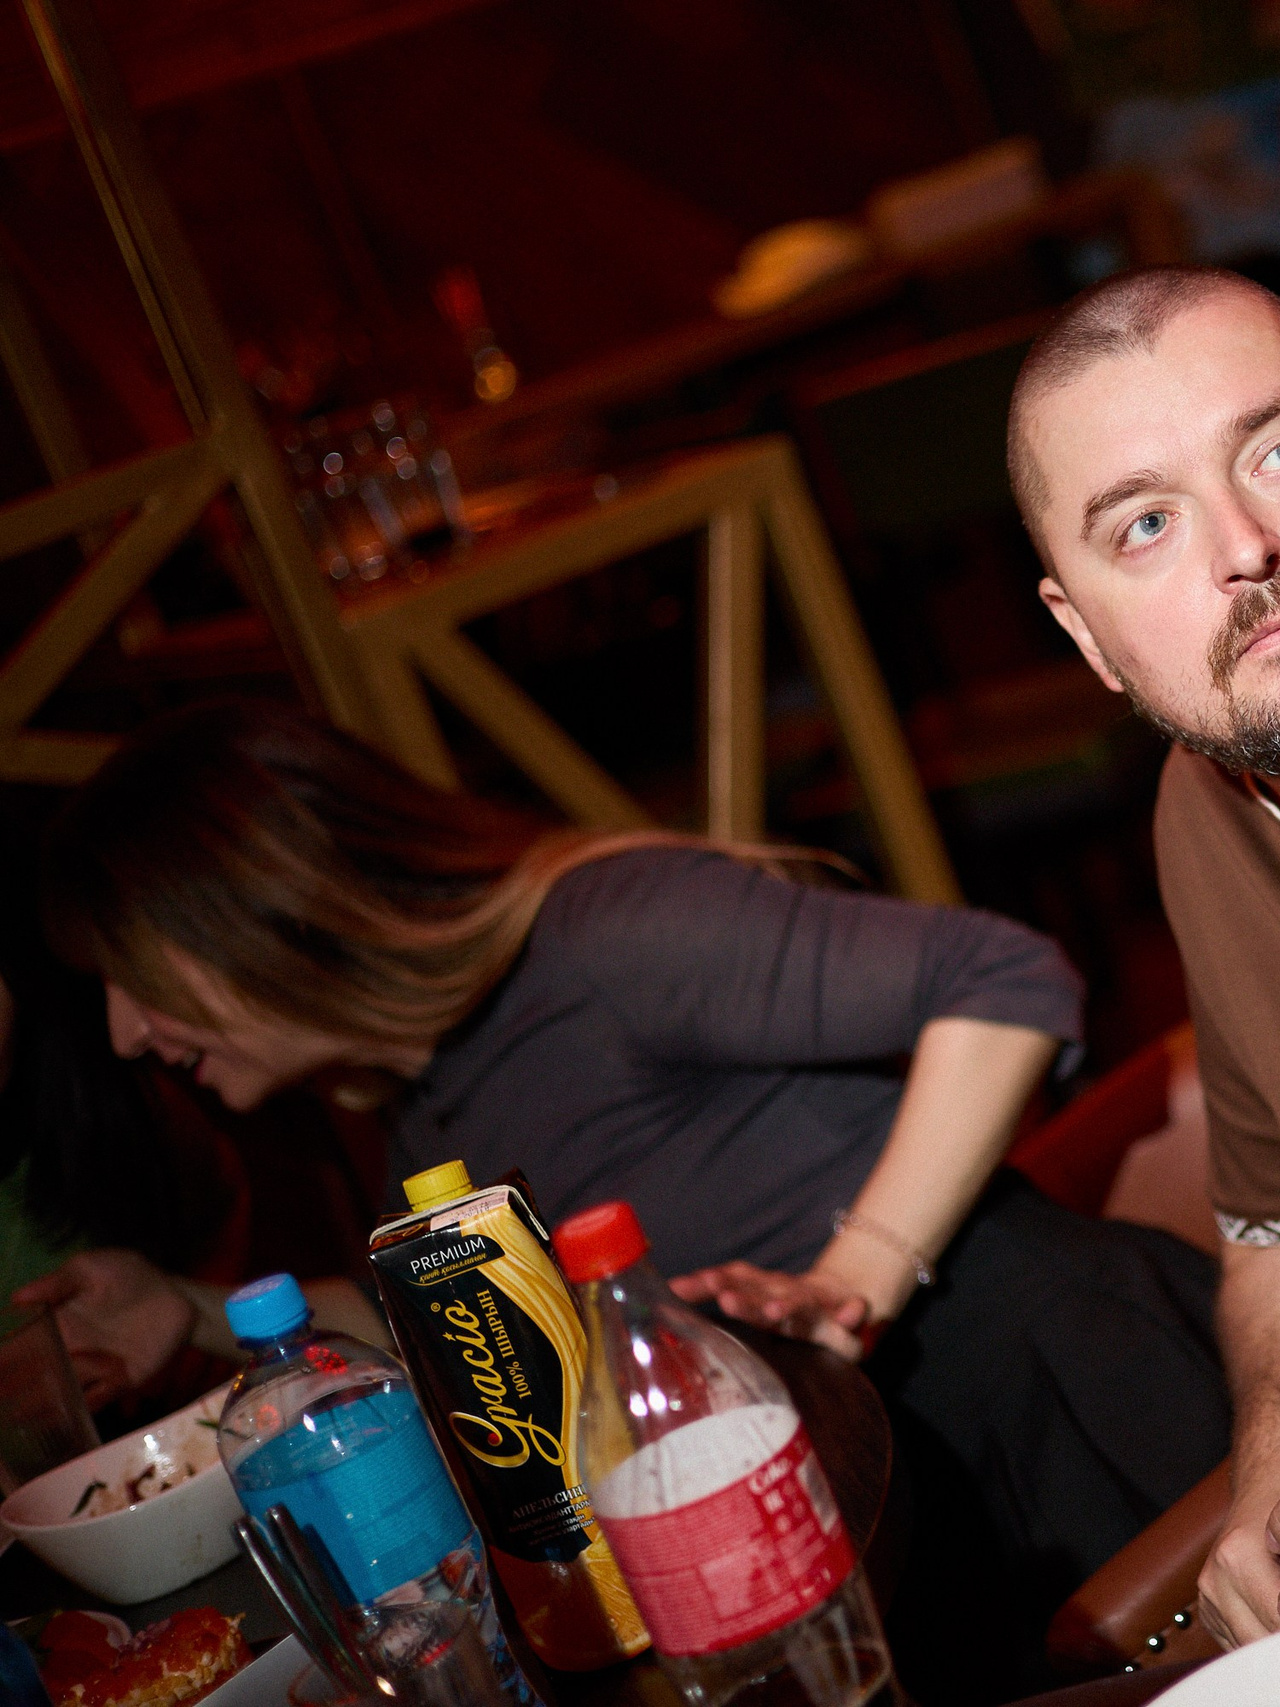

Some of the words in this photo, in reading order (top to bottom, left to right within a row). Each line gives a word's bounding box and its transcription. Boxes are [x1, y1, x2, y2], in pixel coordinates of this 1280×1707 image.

[410, 1236, 486, 1275] PREMIUM
[476, 1289, 515, 1358] ШЫРЫН
[442, 1299, 566, 1468] Gracio
[505, 1361, 532, 1399] 100%
[513, 1484, 587, 1519] АПЕЛЬСИН
